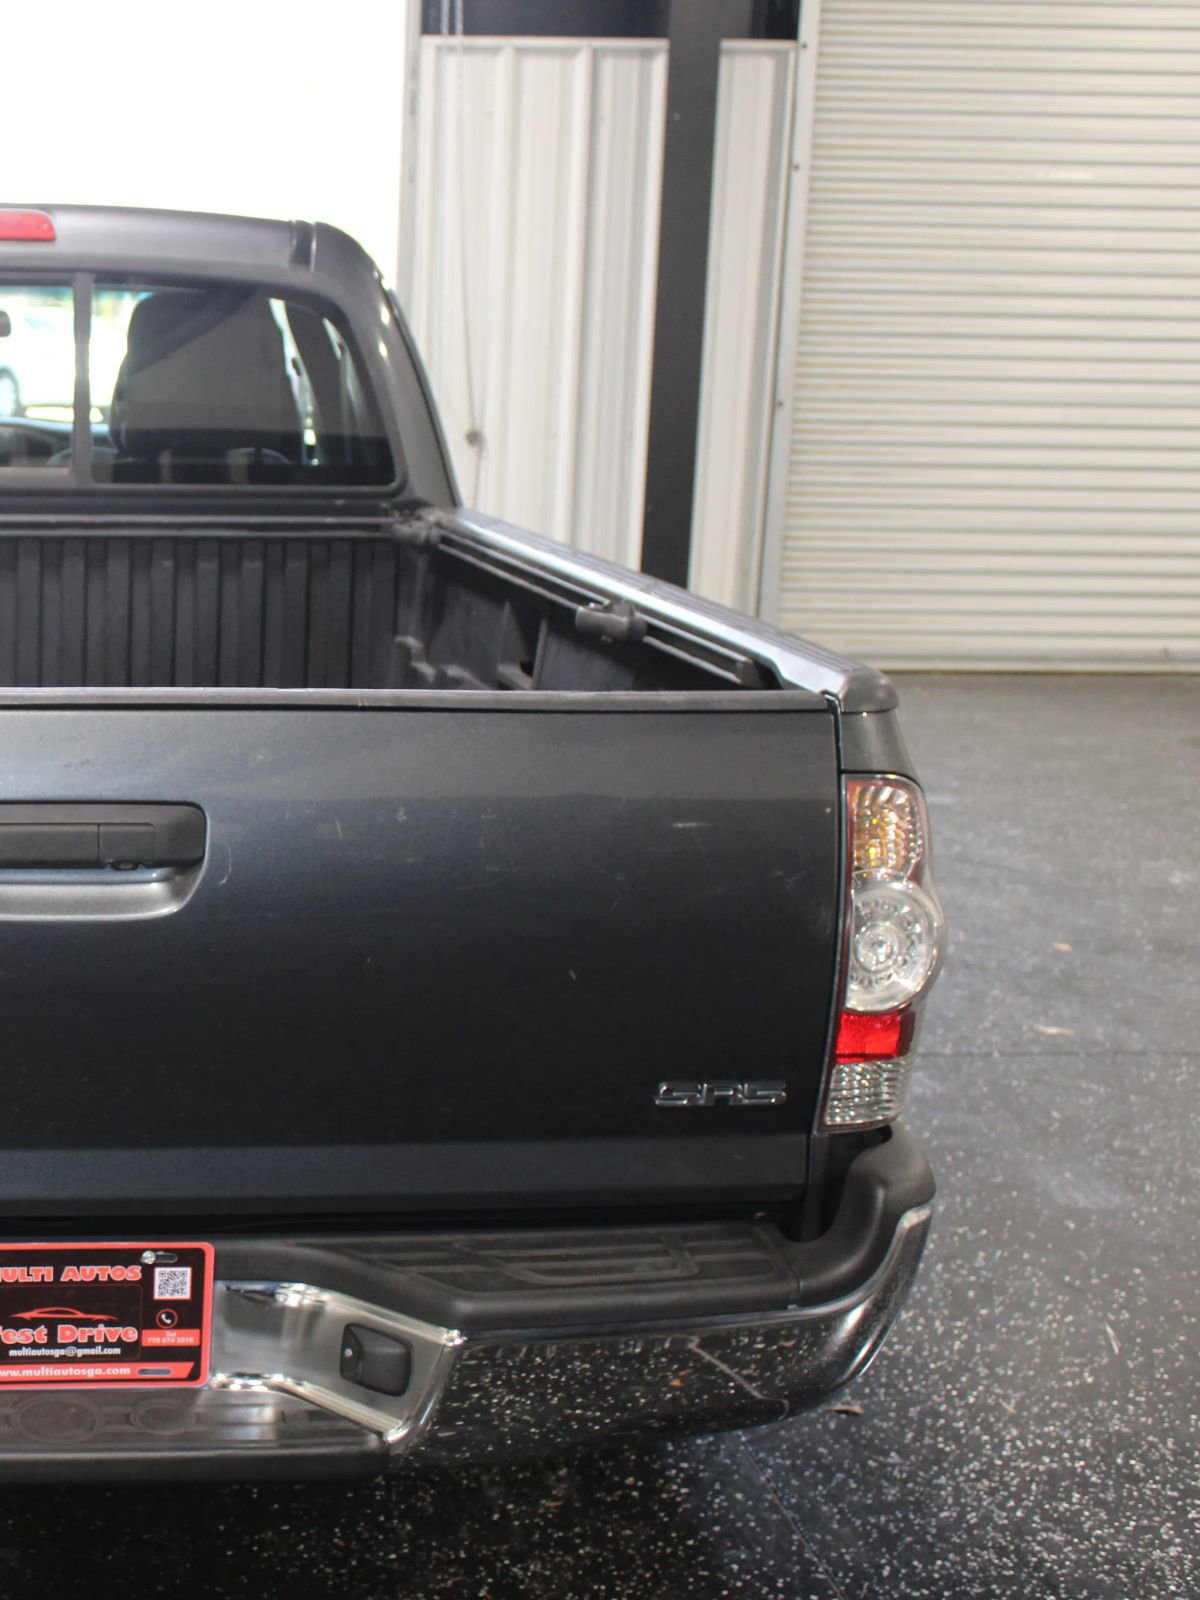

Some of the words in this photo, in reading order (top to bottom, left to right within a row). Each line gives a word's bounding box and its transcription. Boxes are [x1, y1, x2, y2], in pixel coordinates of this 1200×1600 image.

[654, 1081, 787, 1106] SR5
[60, 1265, 142, 1281] AUTOS
[57, 1323, 139, 1343] Drive
[8, 1346, 122, 1357] multiautosga@gmail.com
